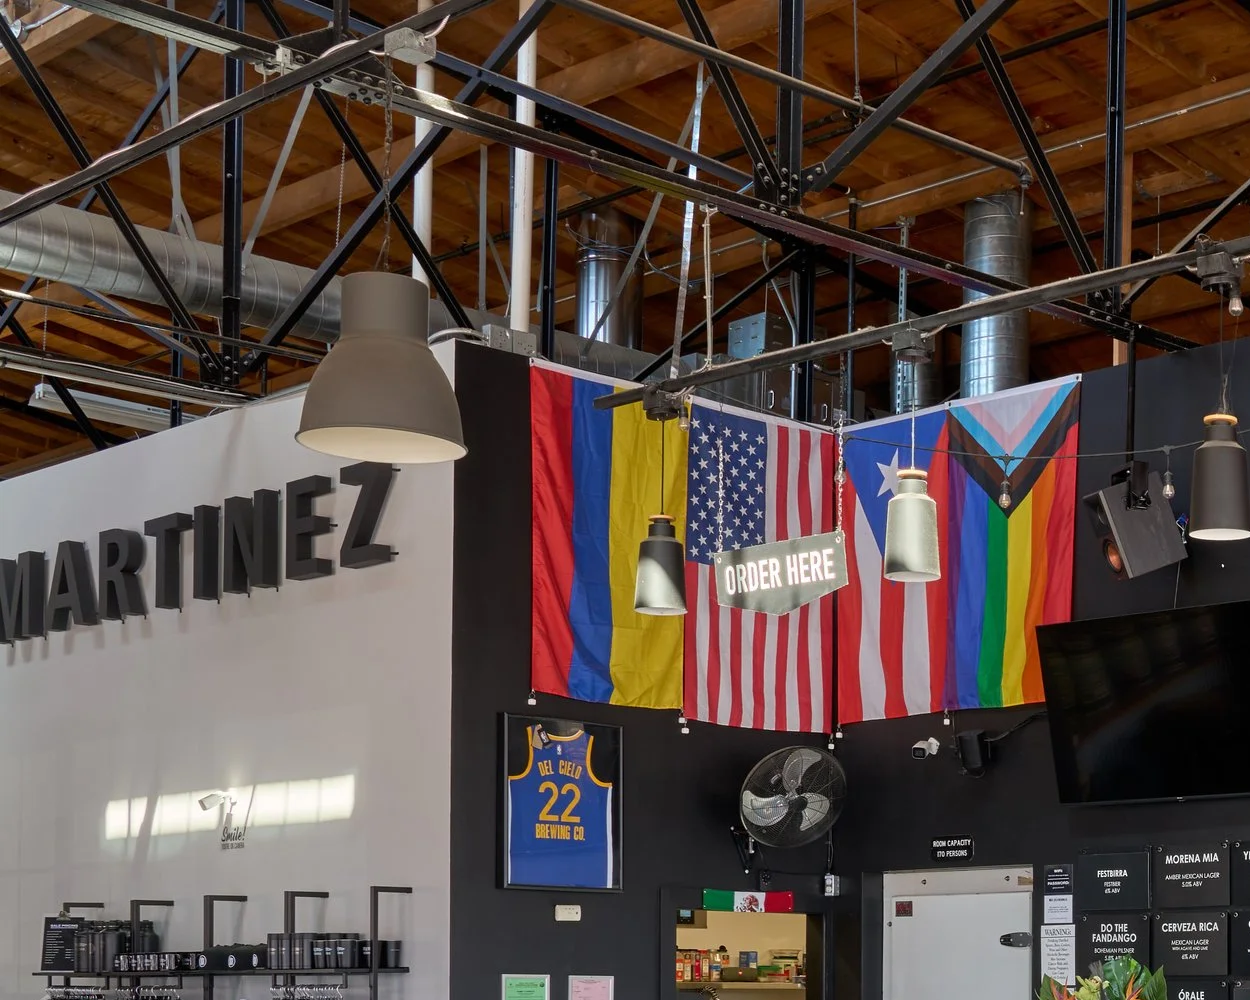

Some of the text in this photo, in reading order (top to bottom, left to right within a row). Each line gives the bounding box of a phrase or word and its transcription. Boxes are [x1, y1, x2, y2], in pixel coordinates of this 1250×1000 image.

[0, 461, 393, 643] MARTINEZ
[724, 548, 836, 595] ORDER HERE
[538, 760, 582, 780] DEL CIELO
[538, 781, 581, 823] 22
[536, 824, 585, 841] BREWING CO.
[936, 850, 945, 858] 170
[1165, 853, 1219, 864] MORENA MIA
[1097, 869, 1128, 878] FESTBIRRA
[1100, 923, 1128, 933] DO THE
[1161, 922, 1219, 932] CERVEZA RICA
[1092, 933, 1137, 943] FANDANGO
[1178, 989, 1205, 1000] ÓRALE
